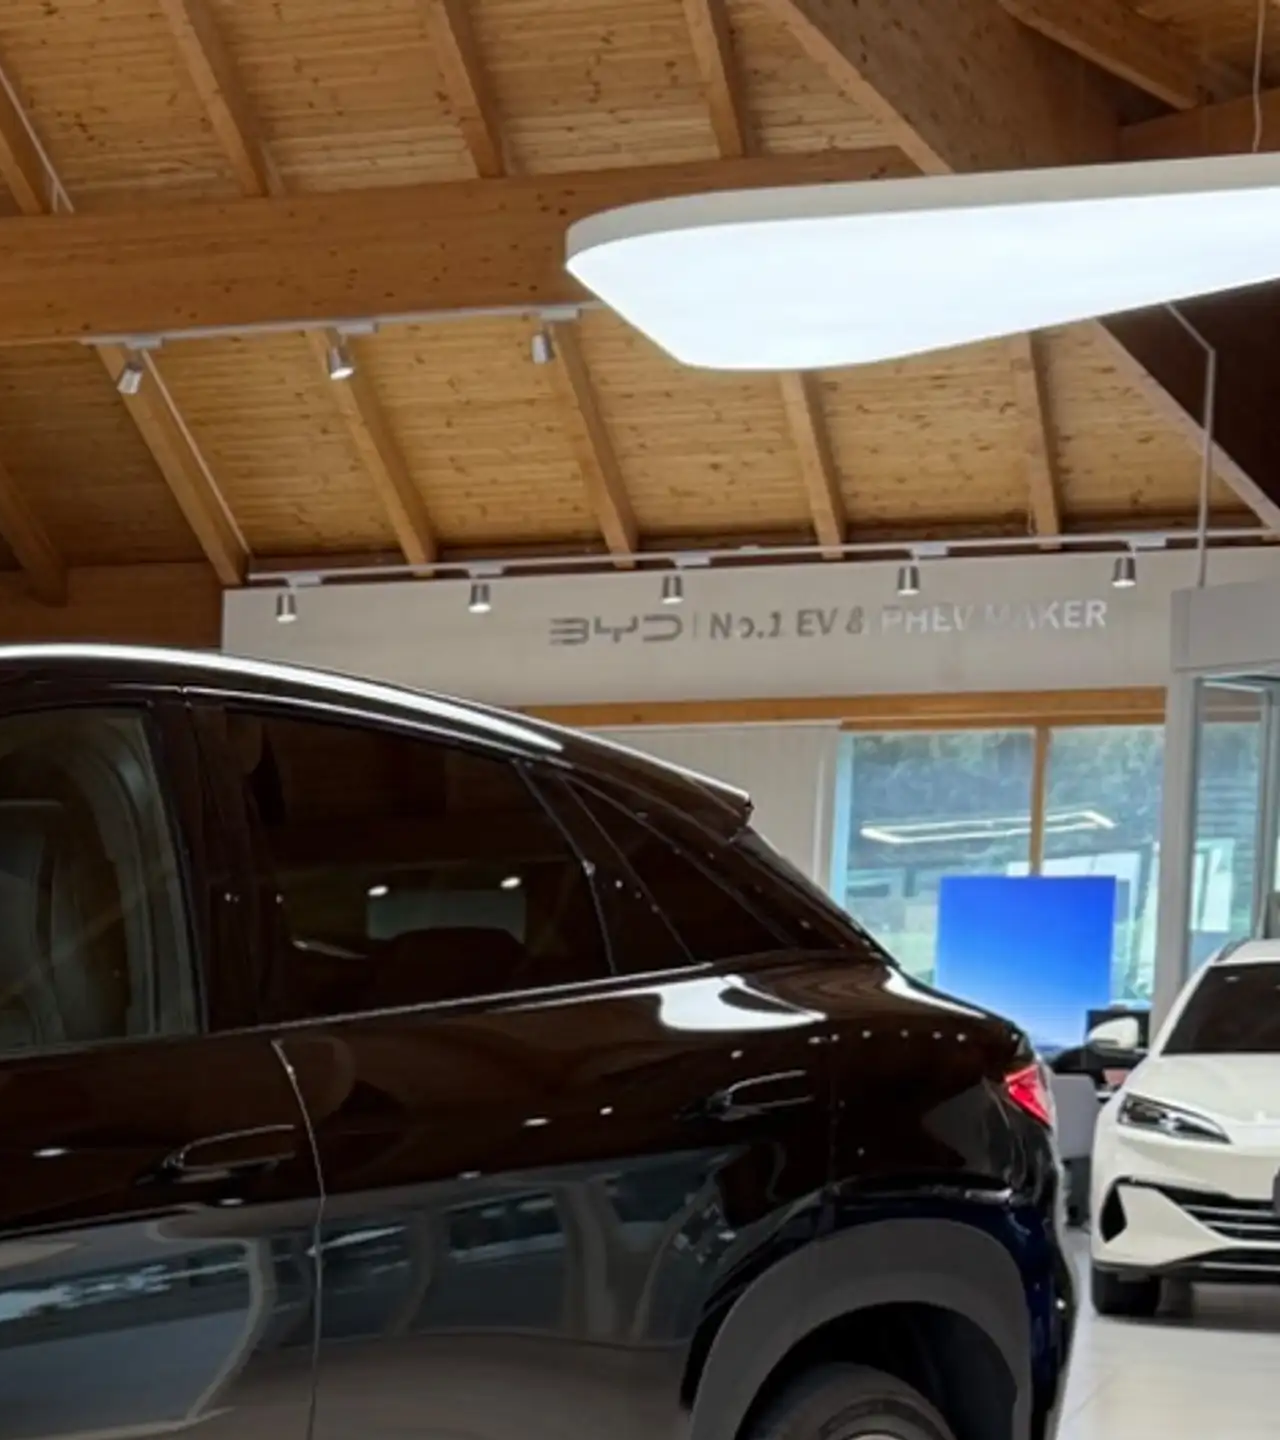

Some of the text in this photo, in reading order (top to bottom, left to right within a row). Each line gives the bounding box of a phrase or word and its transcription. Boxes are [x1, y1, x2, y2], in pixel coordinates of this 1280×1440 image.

[548, 614, 684, 646] BYD
[709, 610, 782, 640] No.1
[796, 607, 839, 637] EV
[881, 602, 976, 634] PHEV
